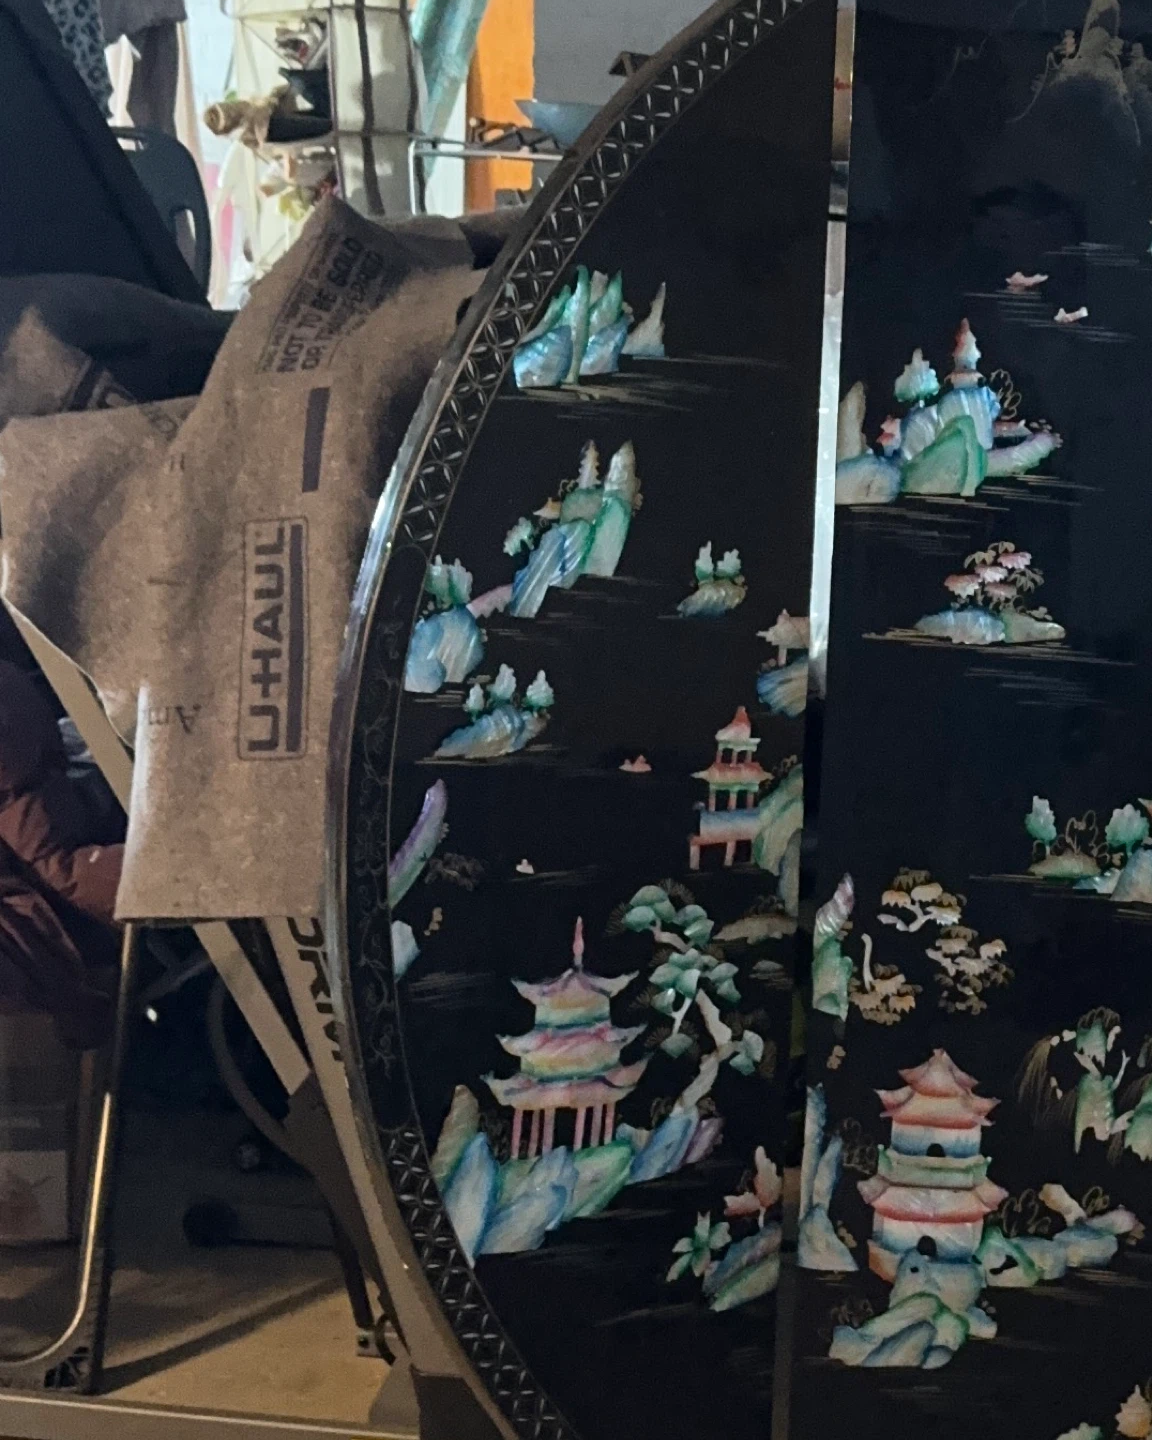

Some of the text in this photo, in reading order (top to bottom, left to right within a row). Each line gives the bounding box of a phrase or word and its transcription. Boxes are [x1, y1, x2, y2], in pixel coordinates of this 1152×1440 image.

[276, 237, 364, 373] NOT TO BE SOLD
[248, 525, 285, 753] U-HAUL
